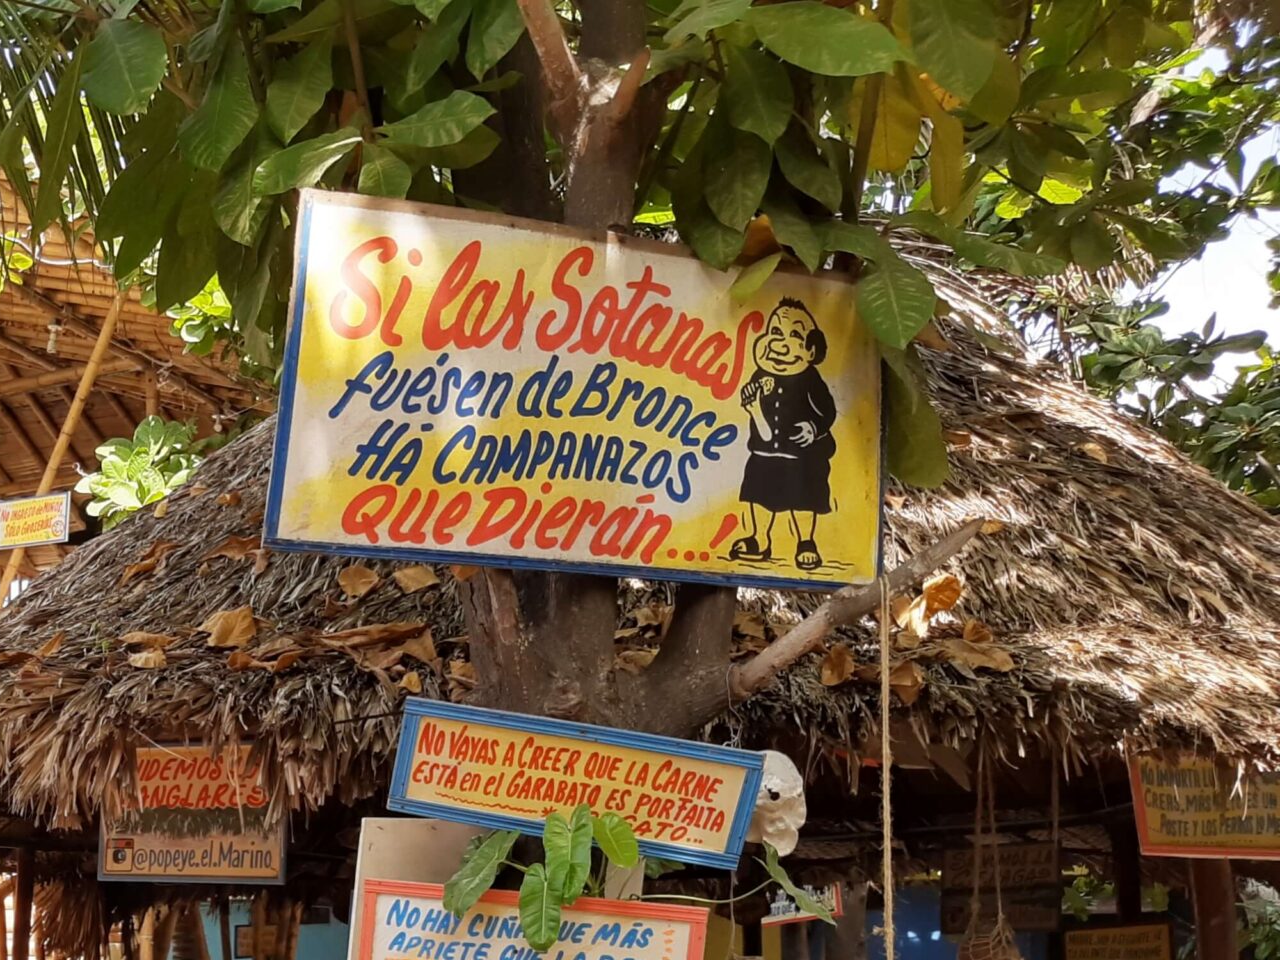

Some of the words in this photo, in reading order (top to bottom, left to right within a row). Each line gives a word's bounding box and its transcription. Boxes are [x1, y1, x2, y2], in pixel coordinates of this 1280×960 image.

[329, 236, 423, 347] Si
[535, 246, 765, 400] Sotanas
[517, 354, 564, 418] de
[574, 362, 738, 462] Bronce
[432, 426, 698, 503] CAMPANAZOS
[448, 725, 499, 766] VAYAS
[502, 741, 516, 767] A
[518, 736, 581, 776] CREER
[584, 751, 623, 781] QUE
[625, 760, 651, 787] LA
[651, 760, 724, 803] CARNE
[459, 772, 481, 792] en
[483, 772, 505, 797] el
[506, 769, 602, 808] GARABATO
[604, 788, 631, 811] ES
[420, 907, 463, 935] HAY
